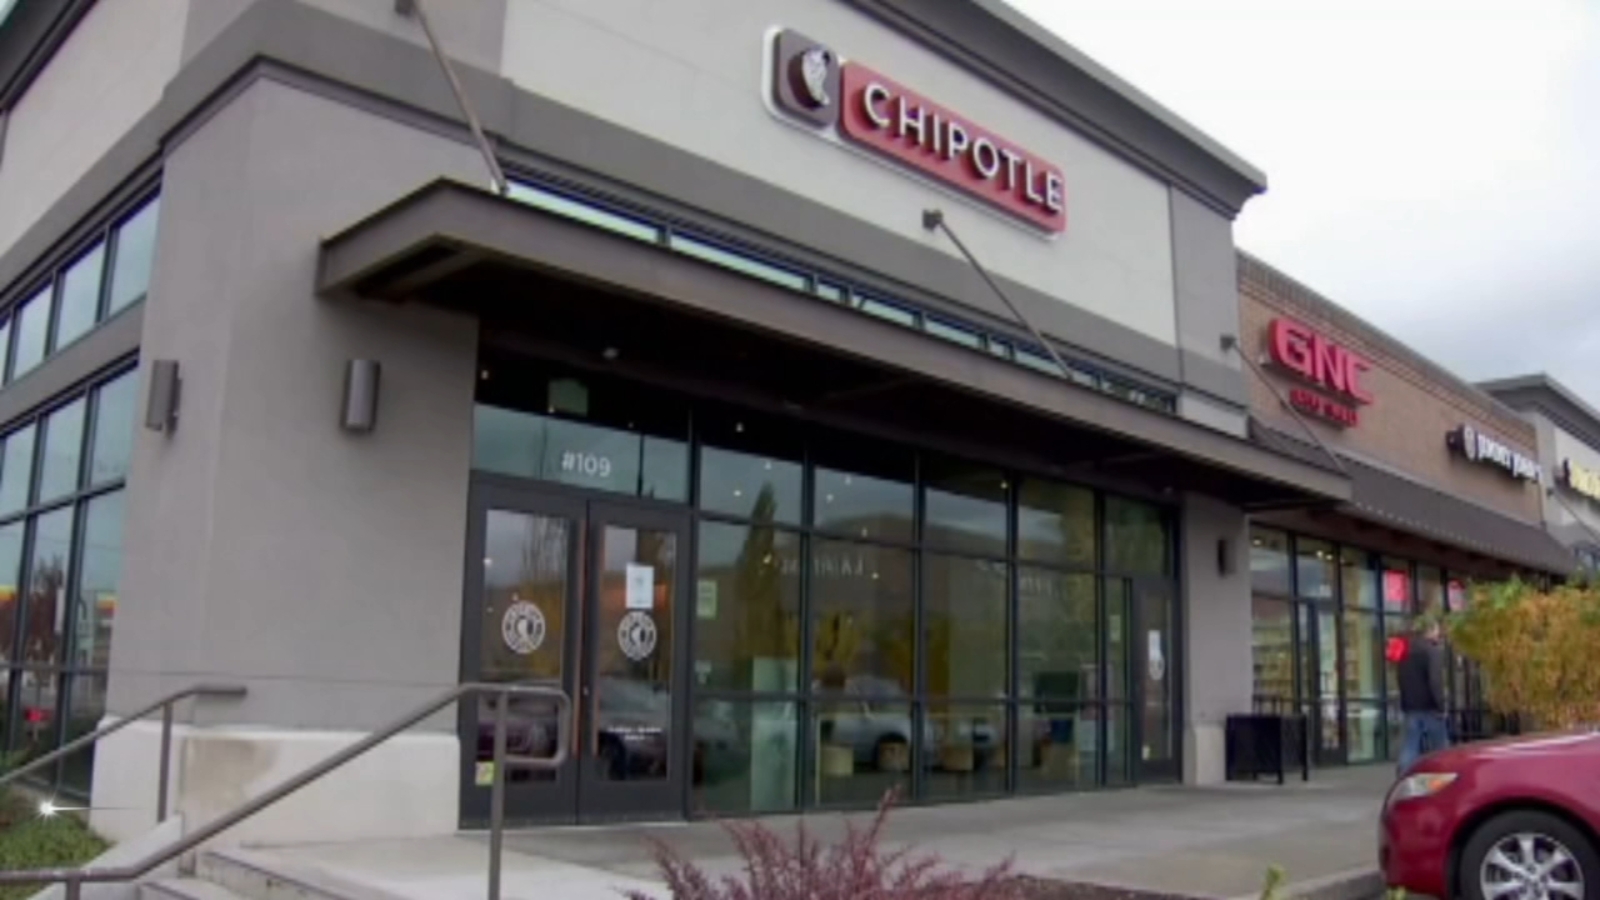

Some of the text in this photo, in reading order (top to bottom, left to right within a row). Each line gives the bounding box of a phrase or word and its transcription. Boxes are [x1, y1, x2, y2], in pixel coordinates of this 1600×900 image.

[864, 82, 1063, 213] CHIPOTLE
[1270, 317, 1373, 405] GNC
[561, 451, 611, 477] #109
